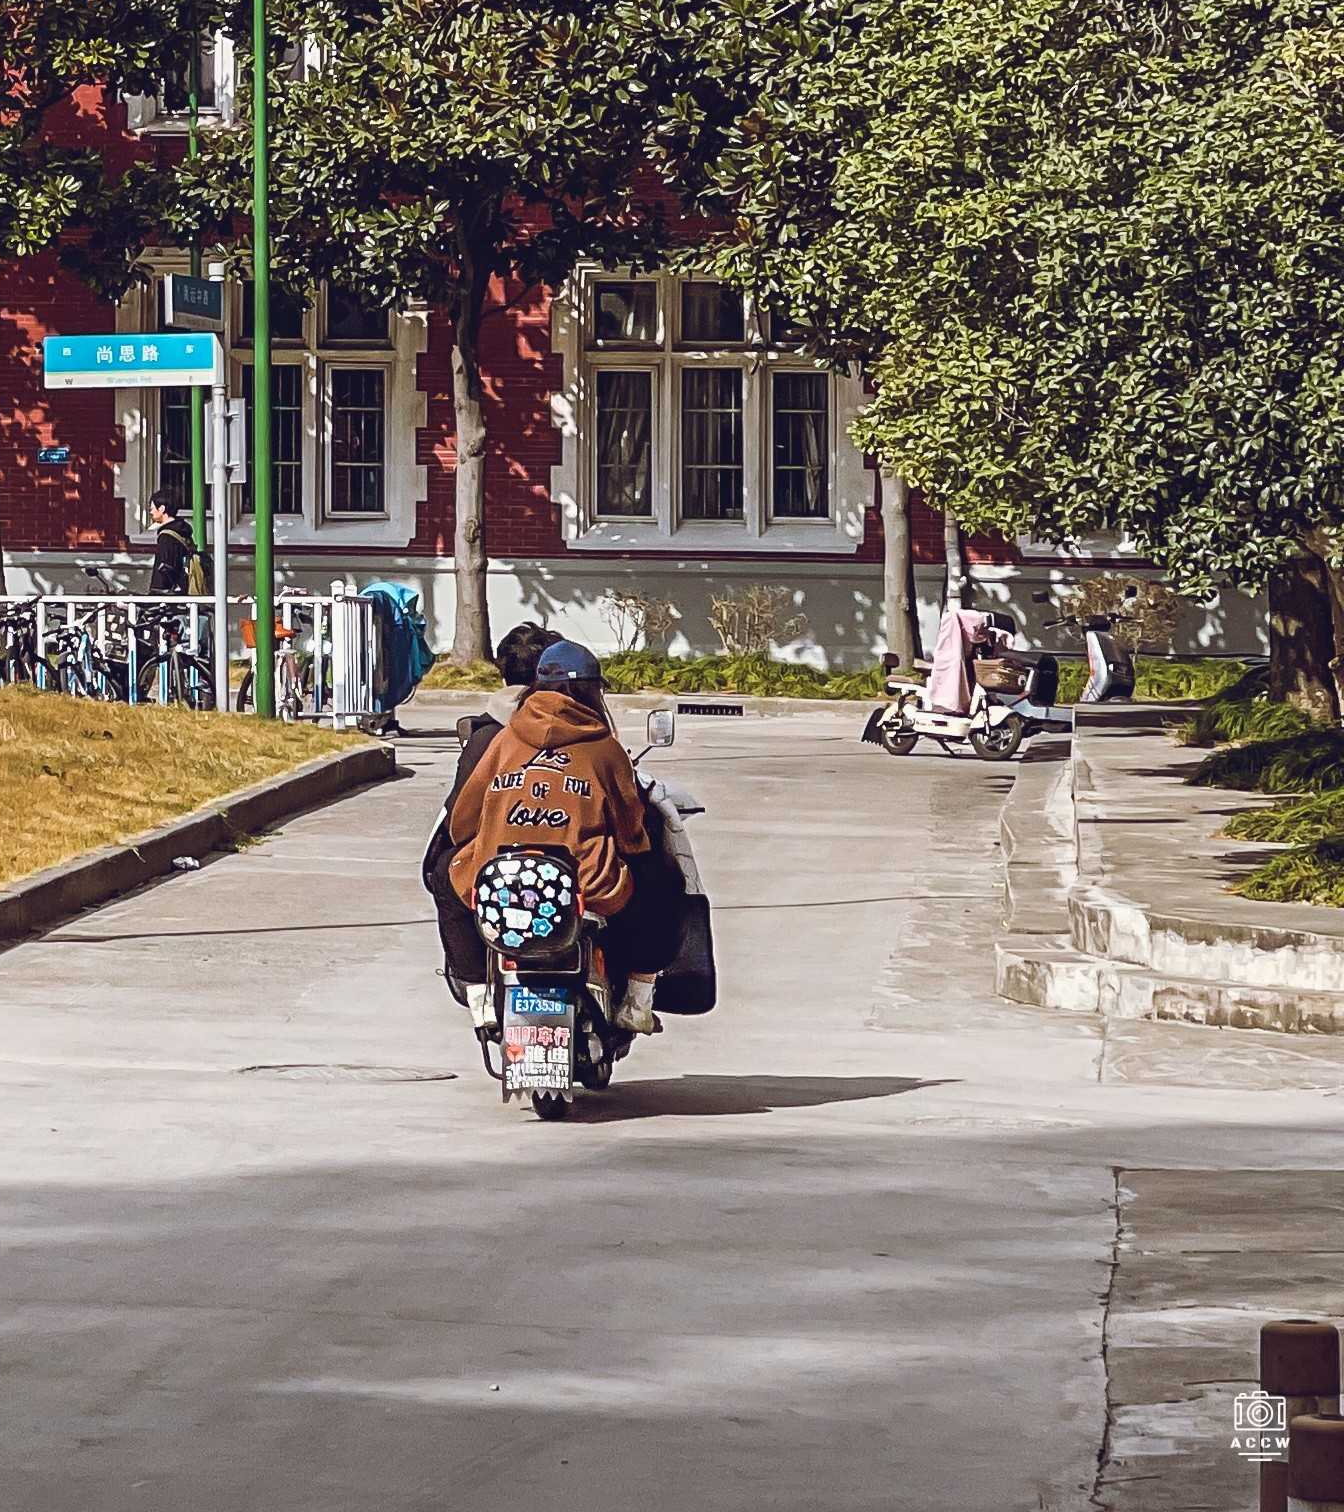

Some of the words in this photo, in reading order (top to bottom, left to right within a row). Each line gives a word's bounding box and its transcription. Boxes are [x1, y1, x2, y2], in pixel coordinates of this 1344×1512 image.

[96, 344, 159, 364] 尚思路
[531, 782, 550, 800] OF
[507, 799, 571, 827] love
